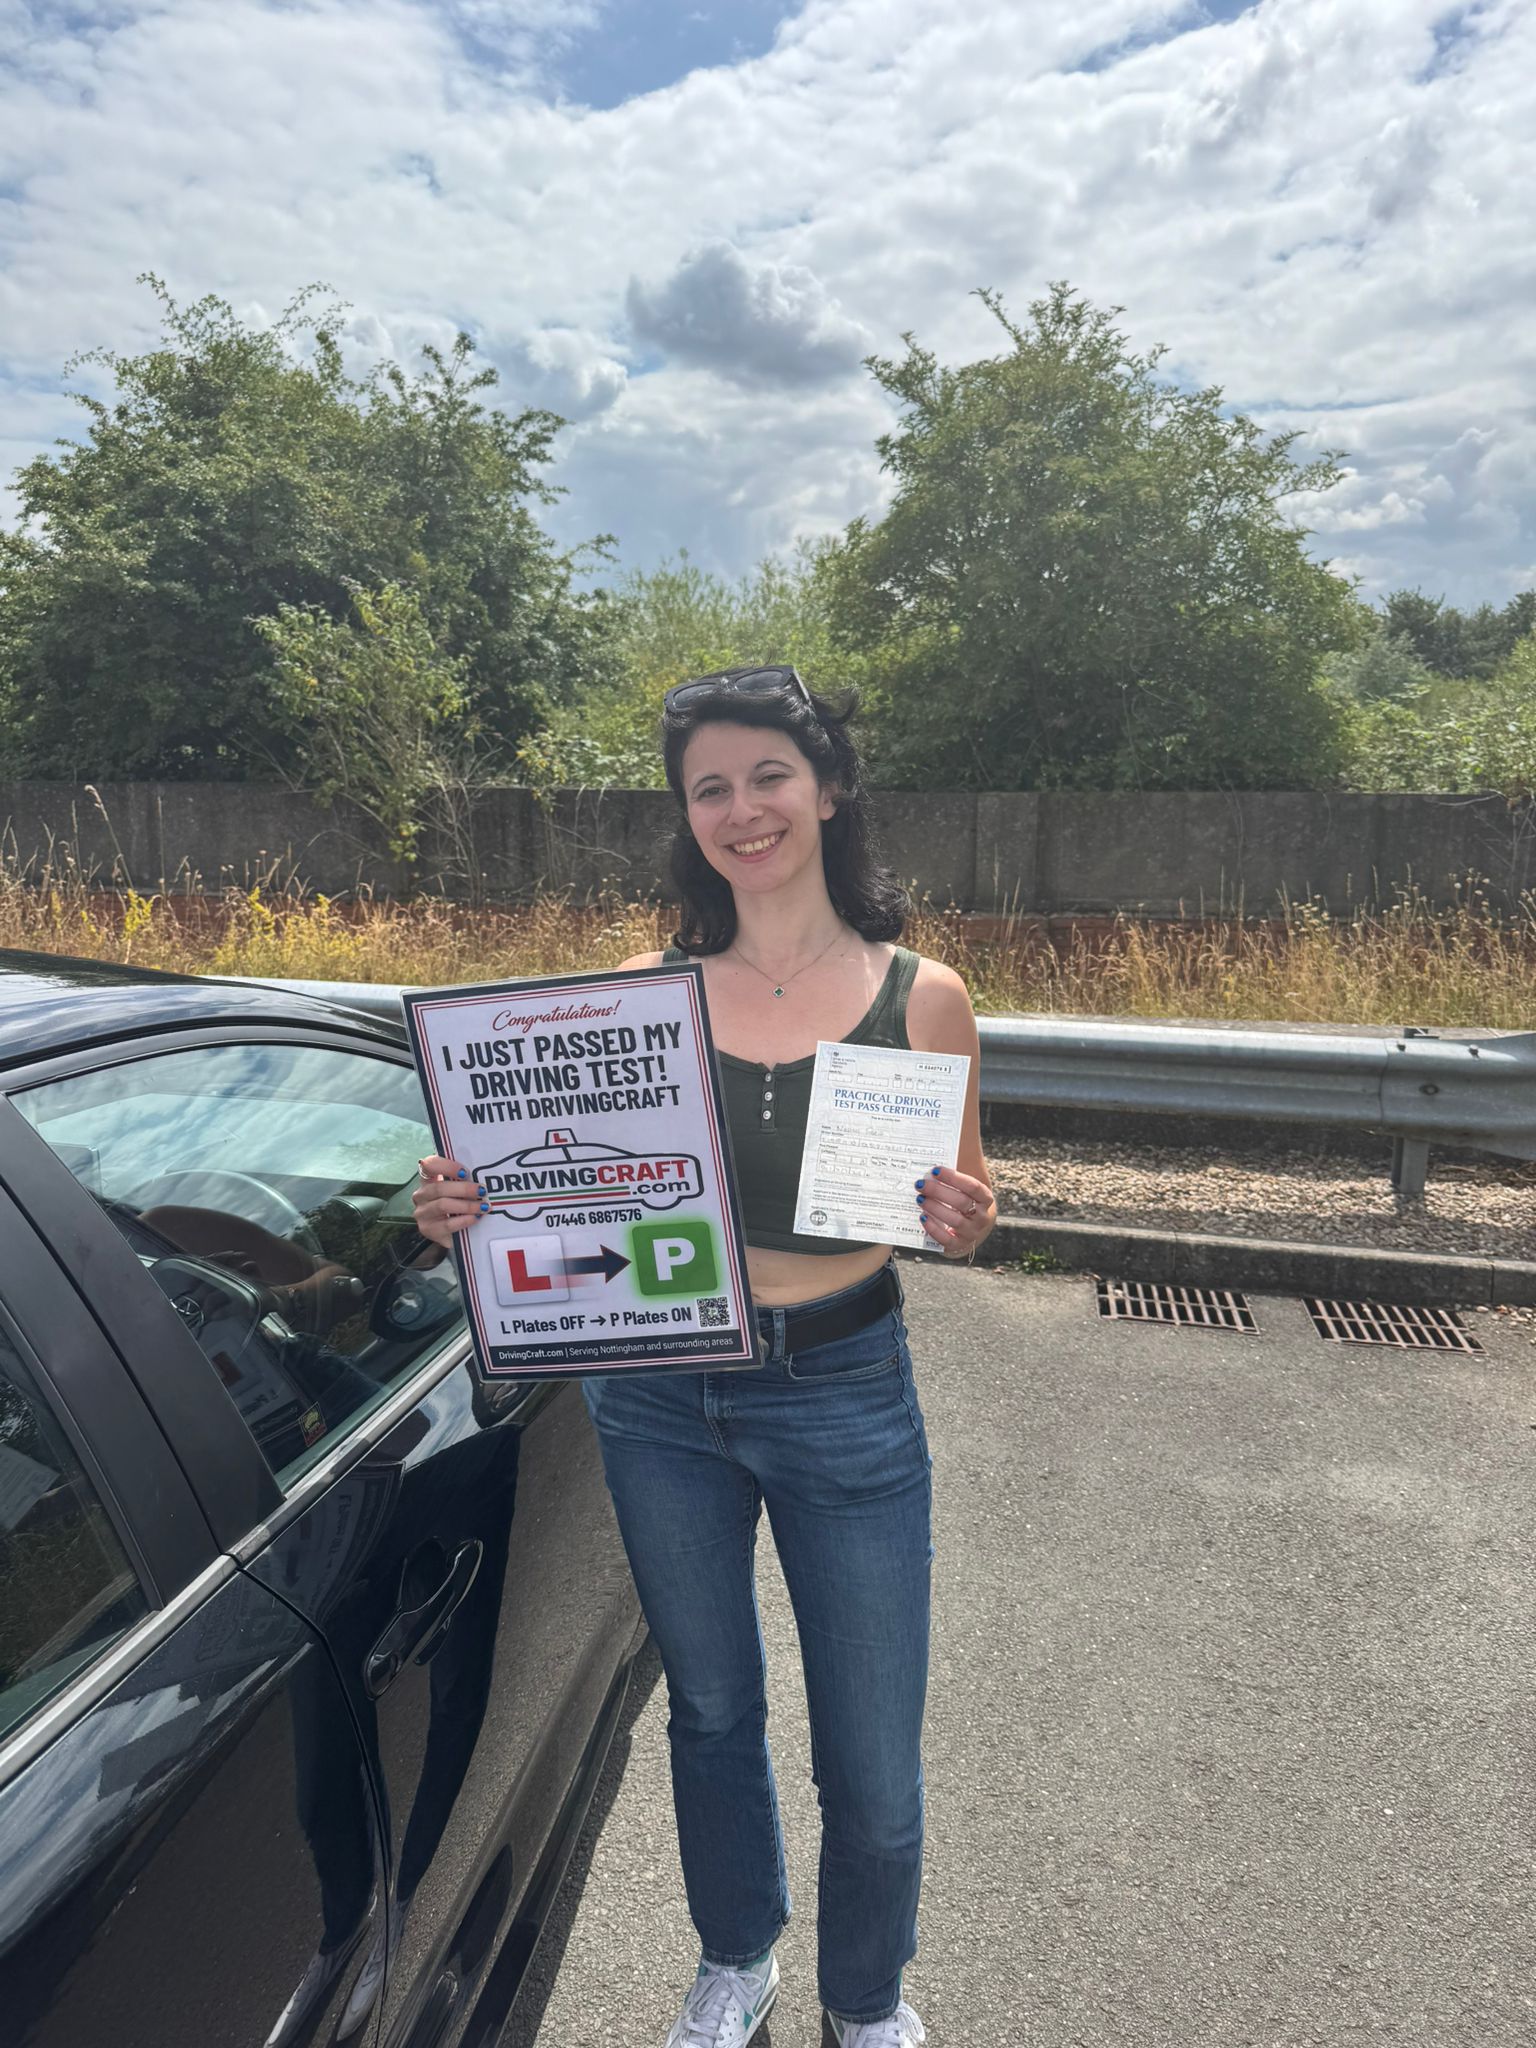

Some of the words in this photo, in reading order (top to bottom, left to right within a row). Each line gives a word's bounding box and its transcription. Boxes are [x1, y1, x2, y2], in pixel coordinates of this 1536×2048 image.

[493, 1000, 622, 1033] Congratulations!
[442, 1045, 453, 1072] I
[460, 1038, 526, 1070] JUST
[534, 1027, 637, 1062] PASSED
[643, 1022, 681, 1051] MY
[470, 1063, 580, 1100] DRIVING
[586, 1055, 667, 1088] TEST!
[465, 1099, 522, 1125] WITH
[526, 1085, 680, 1119] DRIVINGCRAFT
[834, 1089, 892, 1103] PRACTICAL
[894, 1095, 942, 1108] DRIVING
[834, 1099, 856, 1109] TEST
[857, 1102, 880, 1111] PASS
[882, 1104, 940, 1118] CERTIFICATE
[553, 1133, 568, 1143] L
[485, 1160, 688, 1193] DRIVINGCRAFT
[632, 1181, 690, 1195] .com
[546, 1211, 586, 1228] 07446
[589, 1208, 642, 1225] 6867576
[507, 1249, 552, 1293] L
[652, 1237, 696, 1281] P
[500, 1321, 511, 1334] L
[512, 1319, 557, 1334] Plates
[560, 1315, 586, 1330] OFF
[610, 1313, 620, 1326] P
[623, 1311, 669, 1326] Plates
[671, 1307, 692, 1322] ON
[498, 1349, 564, 1360] DrivingCraft.com
[569, 1346, 598, 1356] Serving
[600, 1343, 645, 1354] Nottingham
[646, 1341, 661, 1351] and
[663, 1338, 710, 1349] surrounding
[711, 1337, 733, 1346] areas
